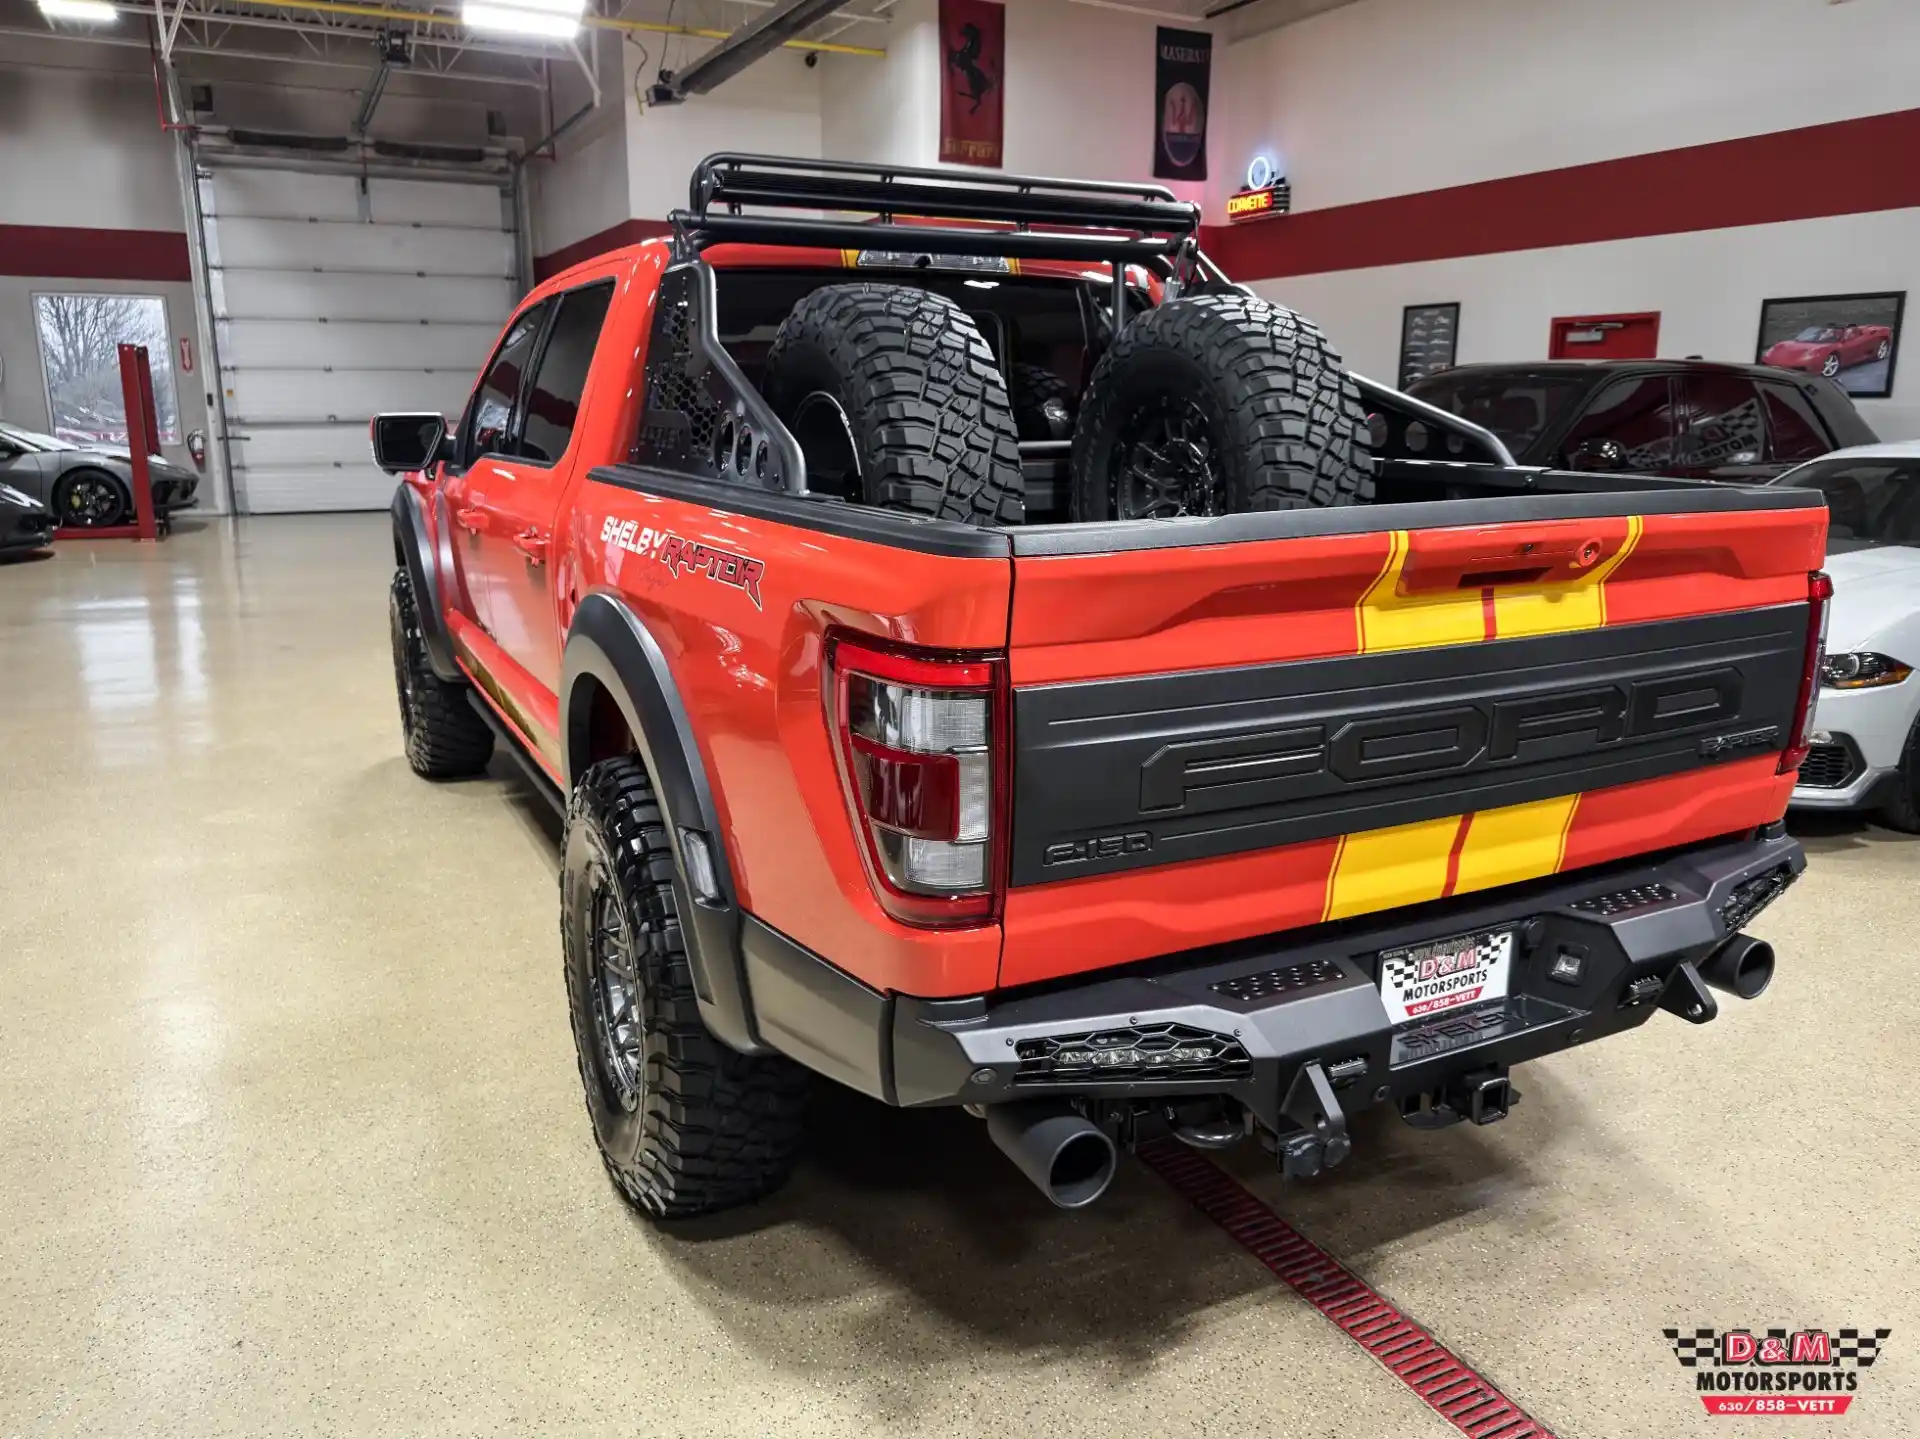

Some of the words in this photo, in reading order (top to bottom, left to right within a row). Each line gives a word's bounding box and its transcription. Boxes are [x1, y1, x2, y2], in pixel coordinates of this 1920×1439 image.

[600, 515, 667, 559] SHELBY
[660, 534, 765, 612] RAPTOR
[1139, 666, 1744, 814] FORD
[1043, 830, 1153, 867] F-150
[1417, 947, 1478, 982] D&M
[1403, 968, 1487, 1002] MOTORSPORTS
